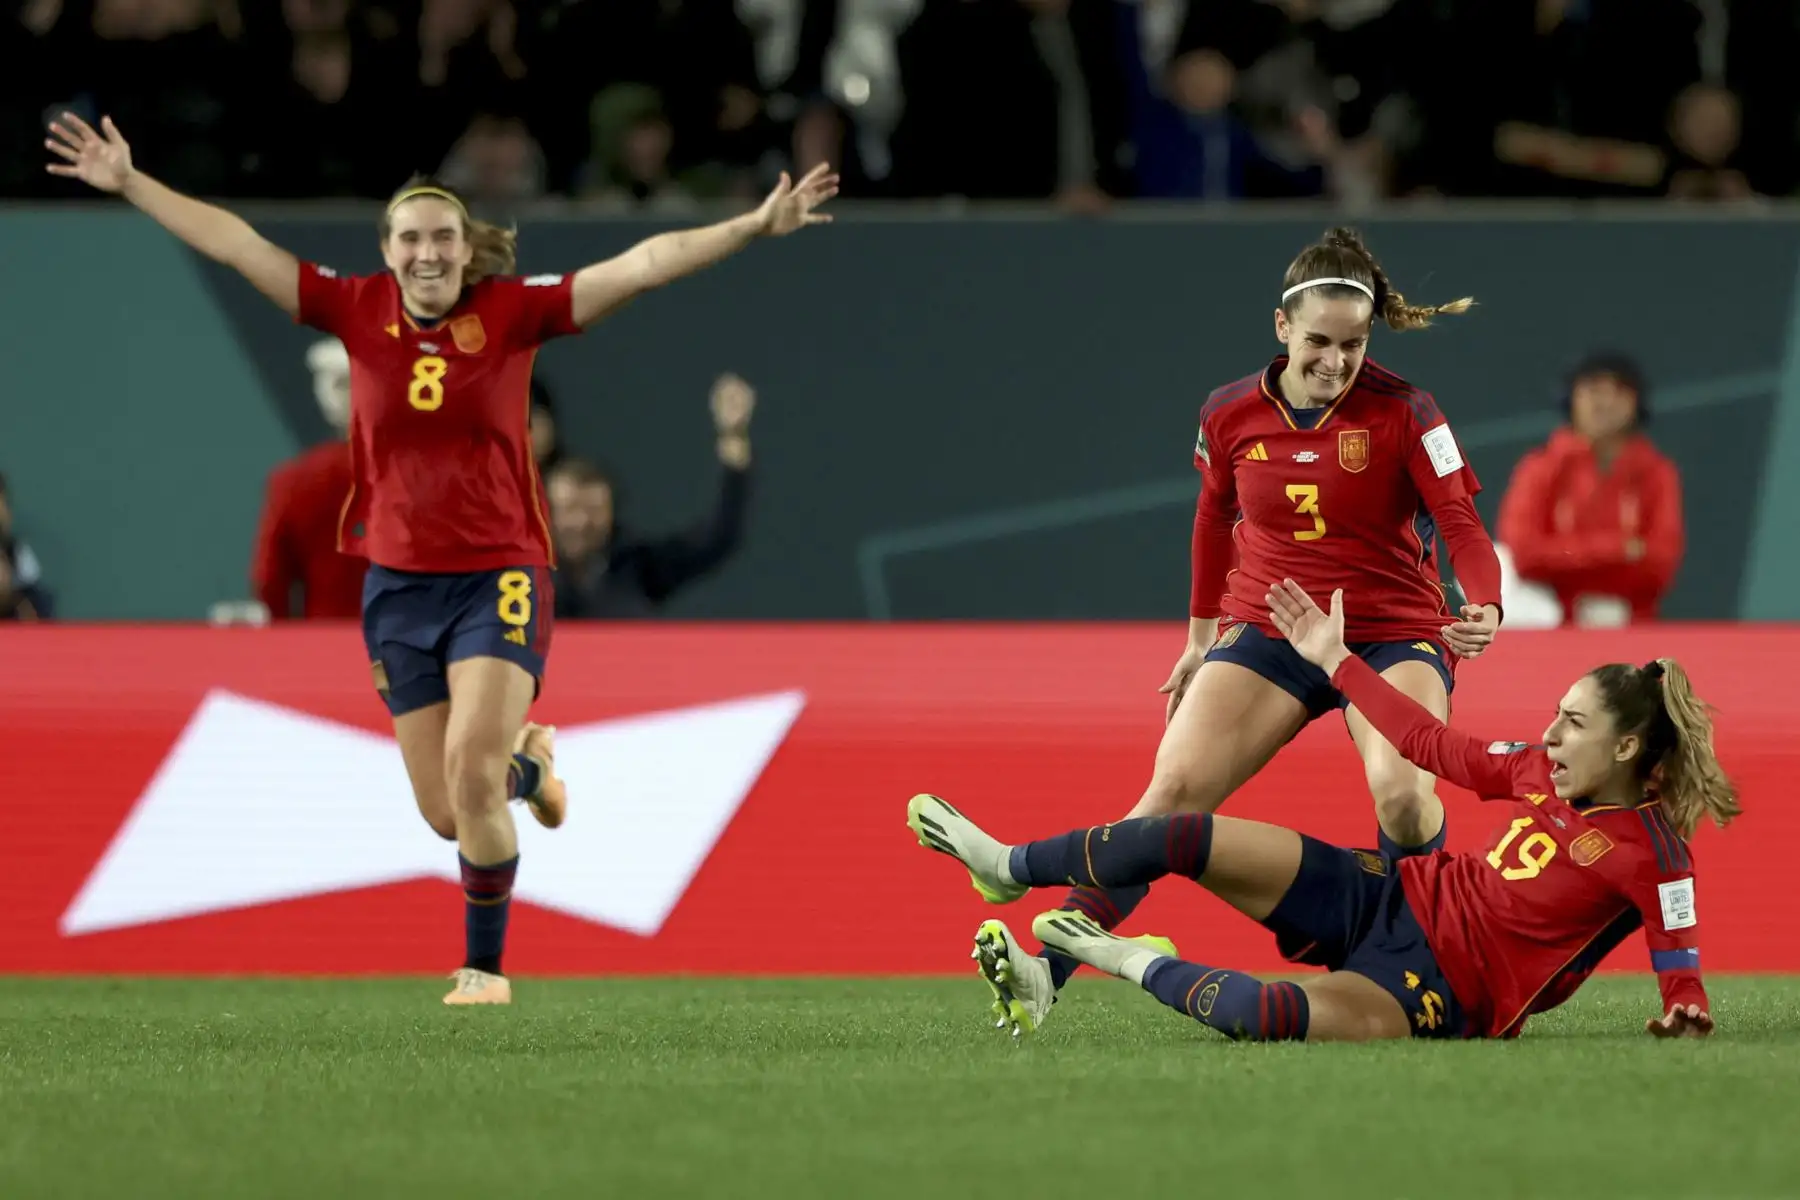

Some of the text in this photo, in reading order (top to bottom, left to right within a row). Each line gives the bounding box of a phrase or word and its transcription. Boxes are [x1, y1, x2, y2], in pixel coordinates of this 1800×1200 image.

[408, 355, 448, 412] 8
[1285, 484, 1326, 541] 3
[496, 570, 532, 626] 8
[1485, 815, 1557, 881] 19
